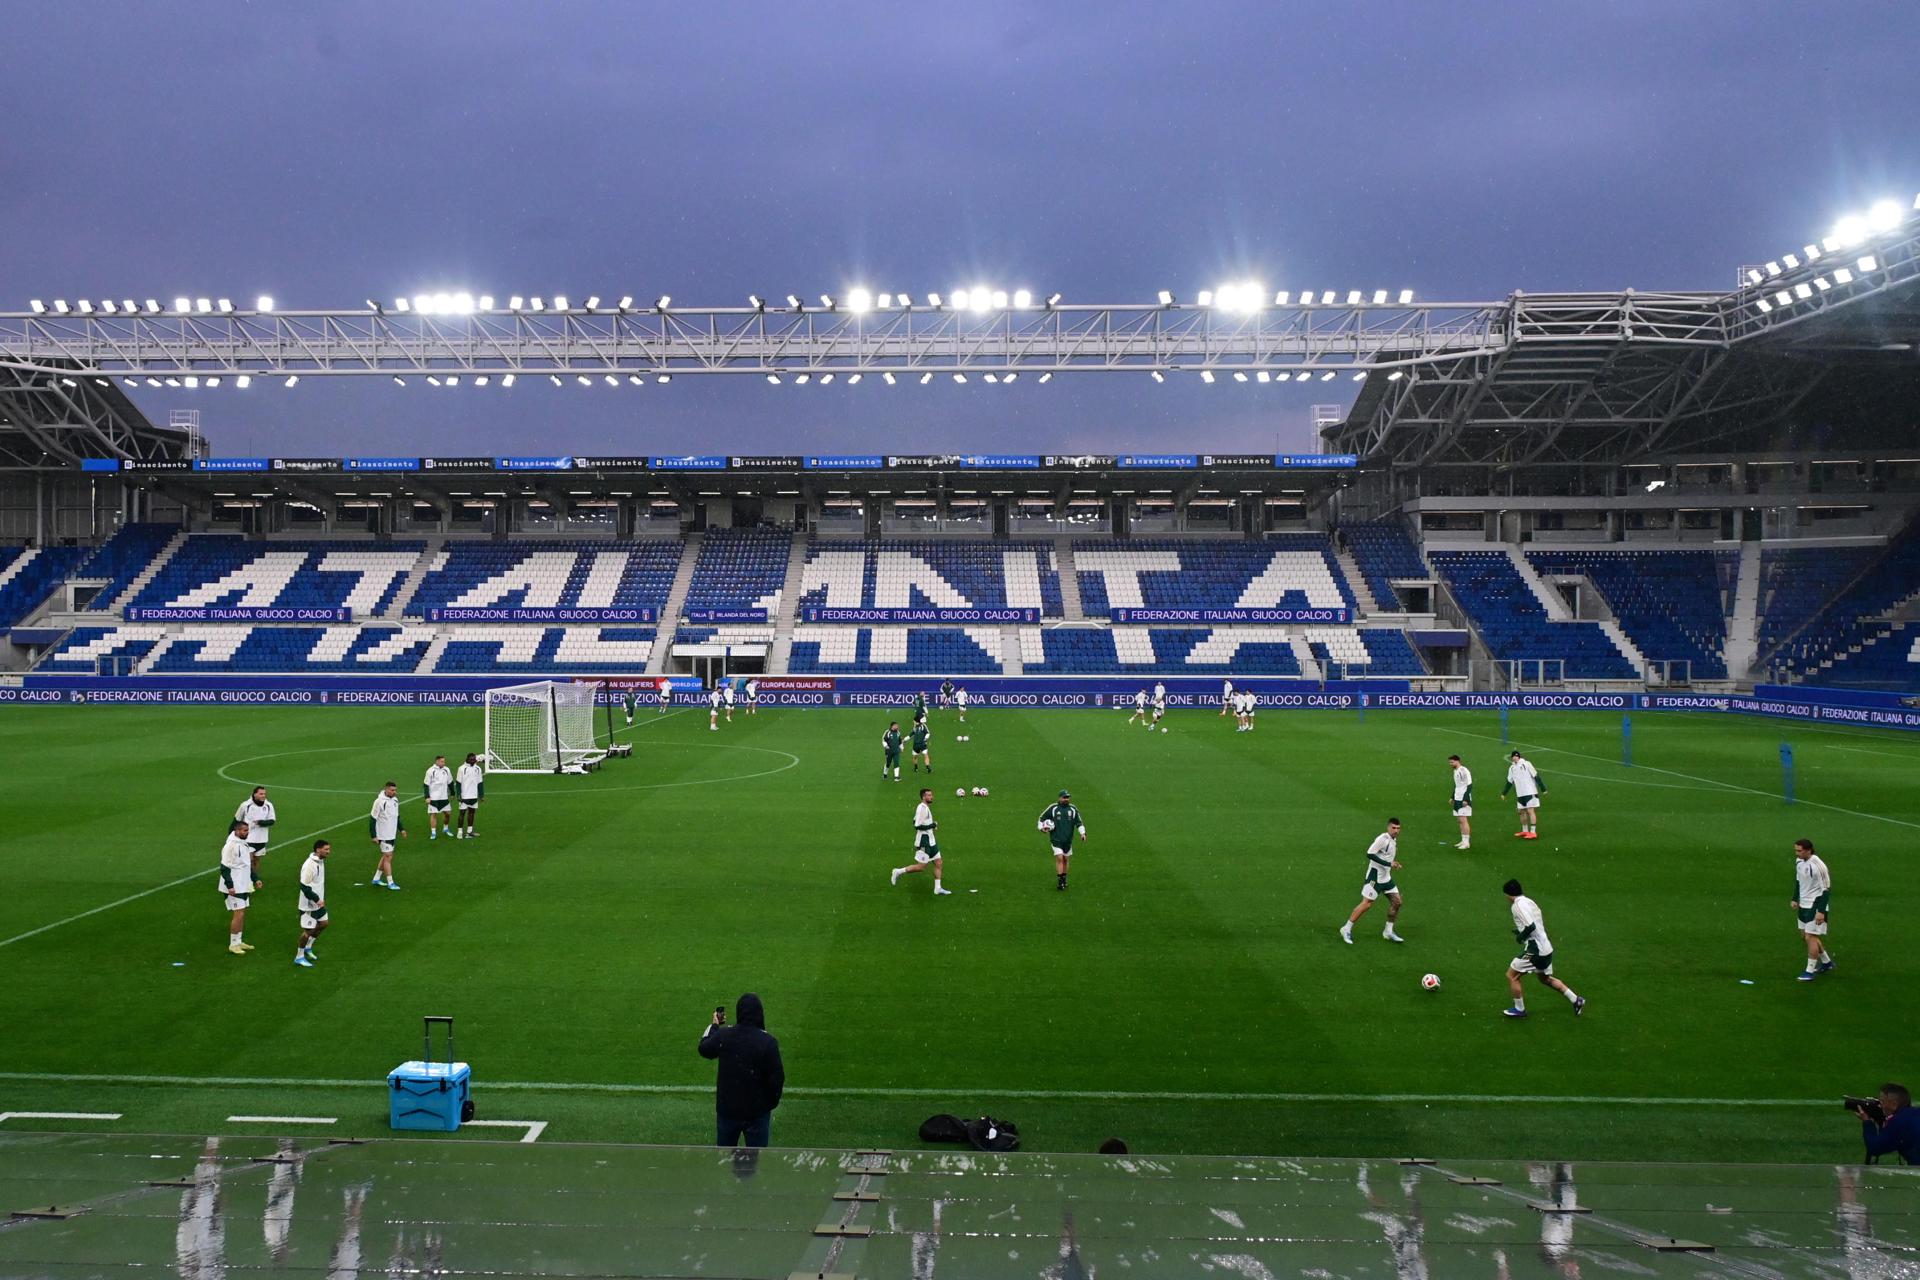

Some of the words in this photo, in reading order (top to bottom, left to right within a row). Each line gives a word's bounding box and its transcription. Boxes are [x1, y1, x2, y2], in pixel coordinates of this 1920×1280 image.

[124, 460, 187, 469] Rinascimento
[200, 461, 262, 469] Rinascimento
[350, 460, 413, 469] Rinascimento
[425, 460, 488, 469] Rinascimento
[578, 459, 642, 468] Rinascimento
[656, 459, 719, 468] Rinascimento
[733, 458, 797, 467] Rinascimento
[811, 458, 875, 467] Rinascimento
[1204, 456, 1270, 465] Rinascimento
[1284, 457, 1350, 465] Rinascimento
[143, 609, 206, 619] FEDERAZIONE
[211, 609, 251, 619] ITALIANA
[256, 609, 293, 619] GIUOCO
[298, 609, 332, 619] CALCIO
[444, 610, 508, 619] FEDERAZIONE
[514, 610, 554, 619] ITALIANA
[559, 610, 598, 619] GIUOCO
[602, 610, 637, 619] CALCIO
[823, 610, 888, 620] FEDERAZIONE
[894, 610, 936, 620] ITALIANA
[941, 610, 980, 620] GIUOCO
[985, 610, 1020, 620] CALCIO
[1132, 610, 1199, 620] FEDERAZIONE
[1205, 610, 1247, 620] ITALIANA
[1252, 610, 1291, 620] GIUOCO
[1296, 610, 1332, 620] CALCIO
[20, 690, 61, 700] CALCIO
[87, 691, 162, 701] FEDERAZIONE
[168, 691, 216, 701] ITALIANA
[221, 691, 265, 702] GIUOCO
[271, 691, 311, 702] CALCIO
[338, 692, 413, 703] FEDERAZIONE
[419, 692, 468, 703] ITALIANA
[781, 693, 823, 704] CALCIO
[990, 694, 1037, 705] GIUOCO
[1042, 694, 1085, 705] CALCIO
[1255, 694, 1302, 706] GIUOCO
[1307, 694, 1351, 706] CALCIO
[1379, 695, 1461, 706] FEDERAZIONE
[1466, 695, 1518, 706] ITALIANA
[1523, 695, 1571, 706] GIUOCO
[1577, 695, 1624, 706] CALCIO
[1732, 699, 1760, 711] ITALIANA
[1761, 702, 1784, 713] GIUOCO
[1786, 704, 1809, 715] CALCIO
[1822, 707, 1868, 721] FEDERAZIONE
[1871, 711, 1903, 724] ITALIANA
